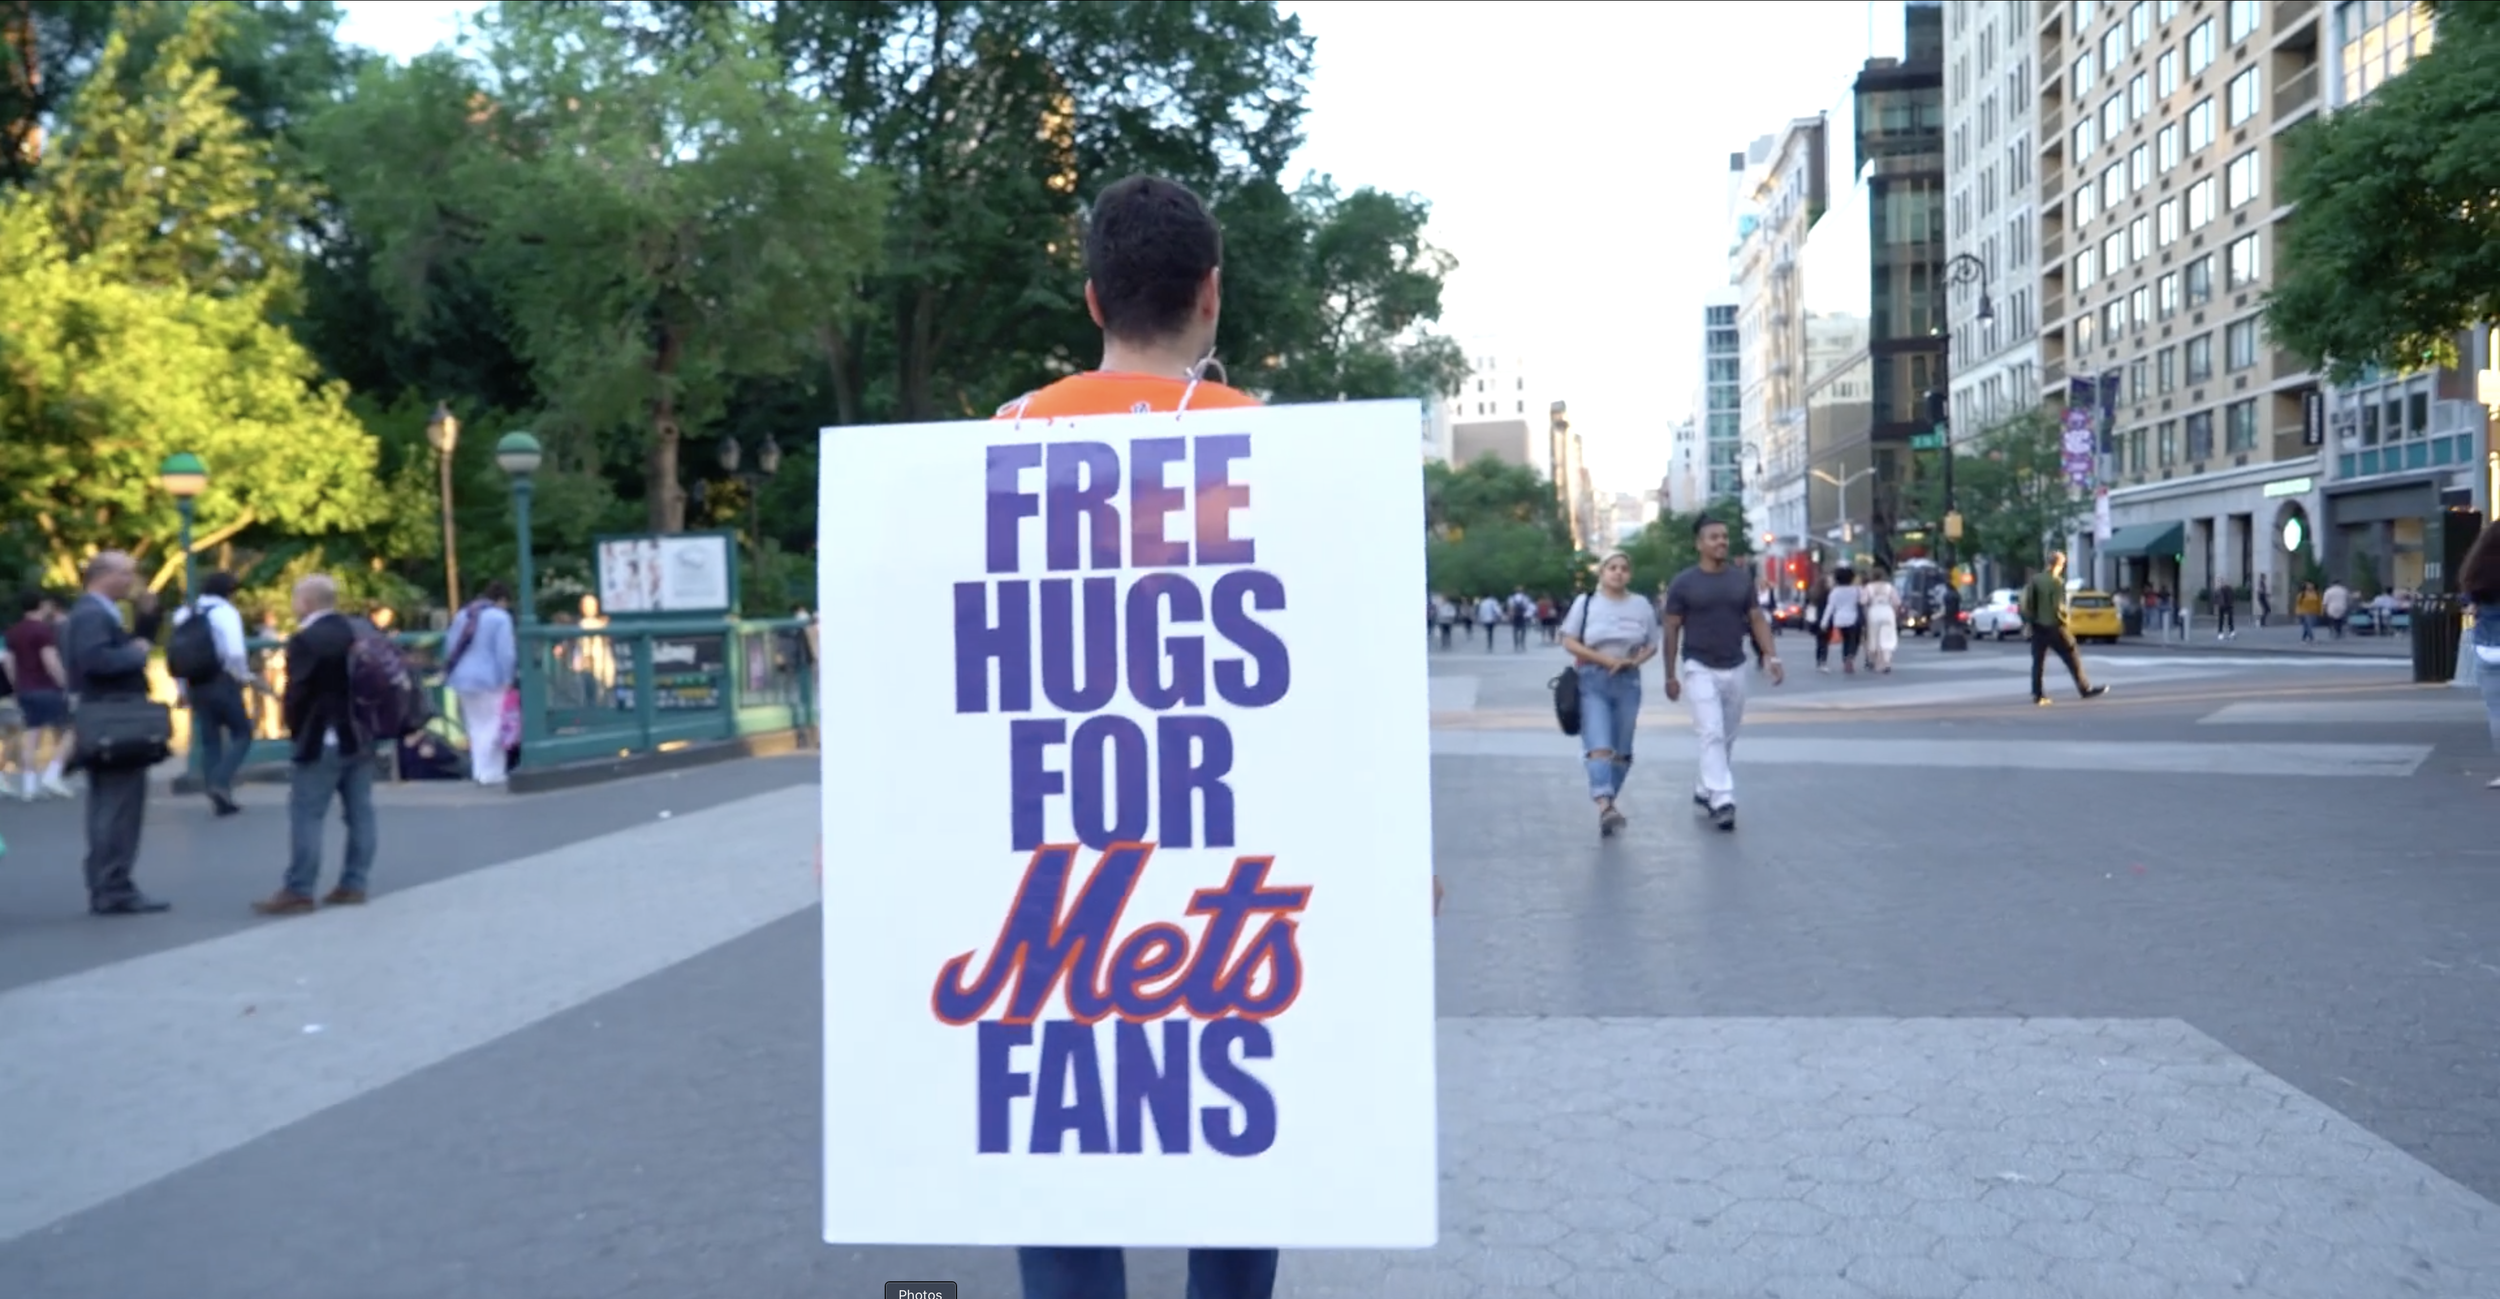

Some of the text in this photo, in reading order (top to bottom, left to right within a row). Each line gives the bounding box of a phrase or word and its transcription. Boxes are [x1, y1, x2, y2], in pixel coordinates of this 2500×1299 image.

[986, 433, 1255, 573] FREE
[954, 569, 1291, 714] HUGS
[1010, 714, 1235, 852] FOR
[931, 841, 1314, 1026] Mets
[976, 1017, 1276, 1157] FANS
